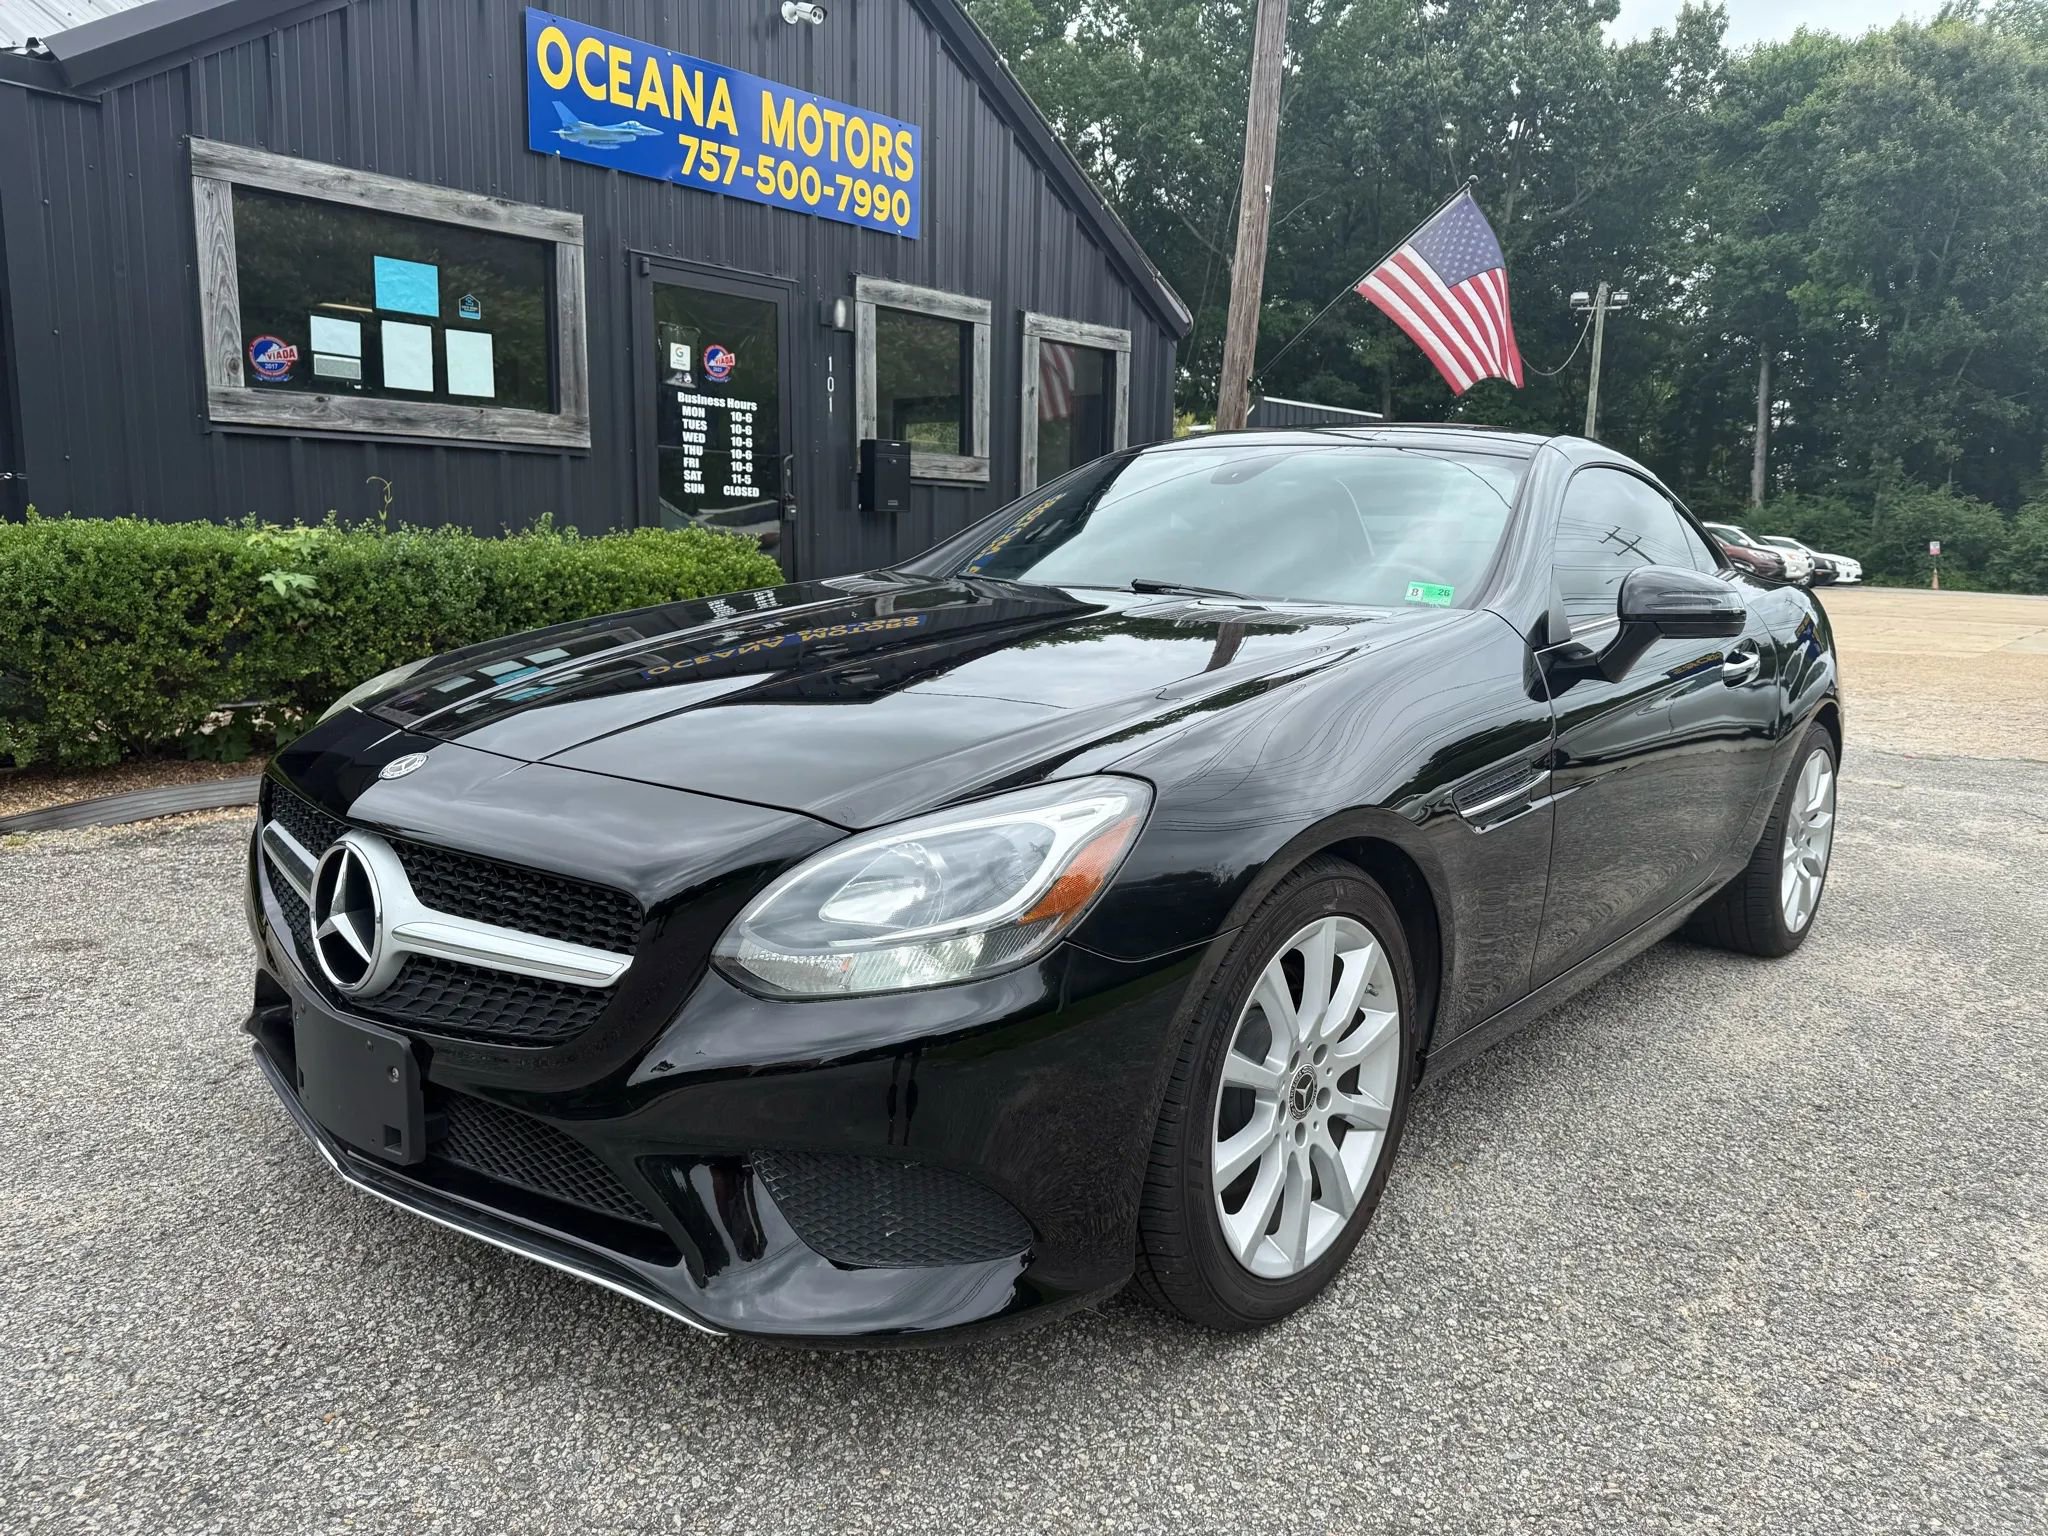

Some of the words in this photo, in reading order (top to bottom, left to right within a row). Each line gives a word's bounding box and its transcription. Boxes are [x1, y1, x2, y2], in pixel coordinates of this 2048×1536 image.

[536, 26, 739, 136] OCEANA
[761, 90, 914, 182] MOTORS
[678, 133, 911, 227] 757-500-7990
[266, 347, 297, 360] VIADA
[677, 391, 726, 408] Business
[726, 397, 758, 411] Hours
[682, 405, 705, 418] MON
[730, 411, 753, 423] 10-6
[682, 418, 707, 431] TUES
[730, 423, 752, 436] 10-6
[682, 431, 706, 444] WED
[730, 436, 753, 448] 10-6
[682, 444, 704, 456] THU
[730, 448, 753, 460] 10-6
[683, 457, 700, 469] FRI
[730, 461, 753, 473] 10-6
[683, 469, 703, 482] SAT
[731, 473, 752, 485] 11-5
[684, 482, 705, 494] SUN
[723, 485, 760, 498] CLOSED
